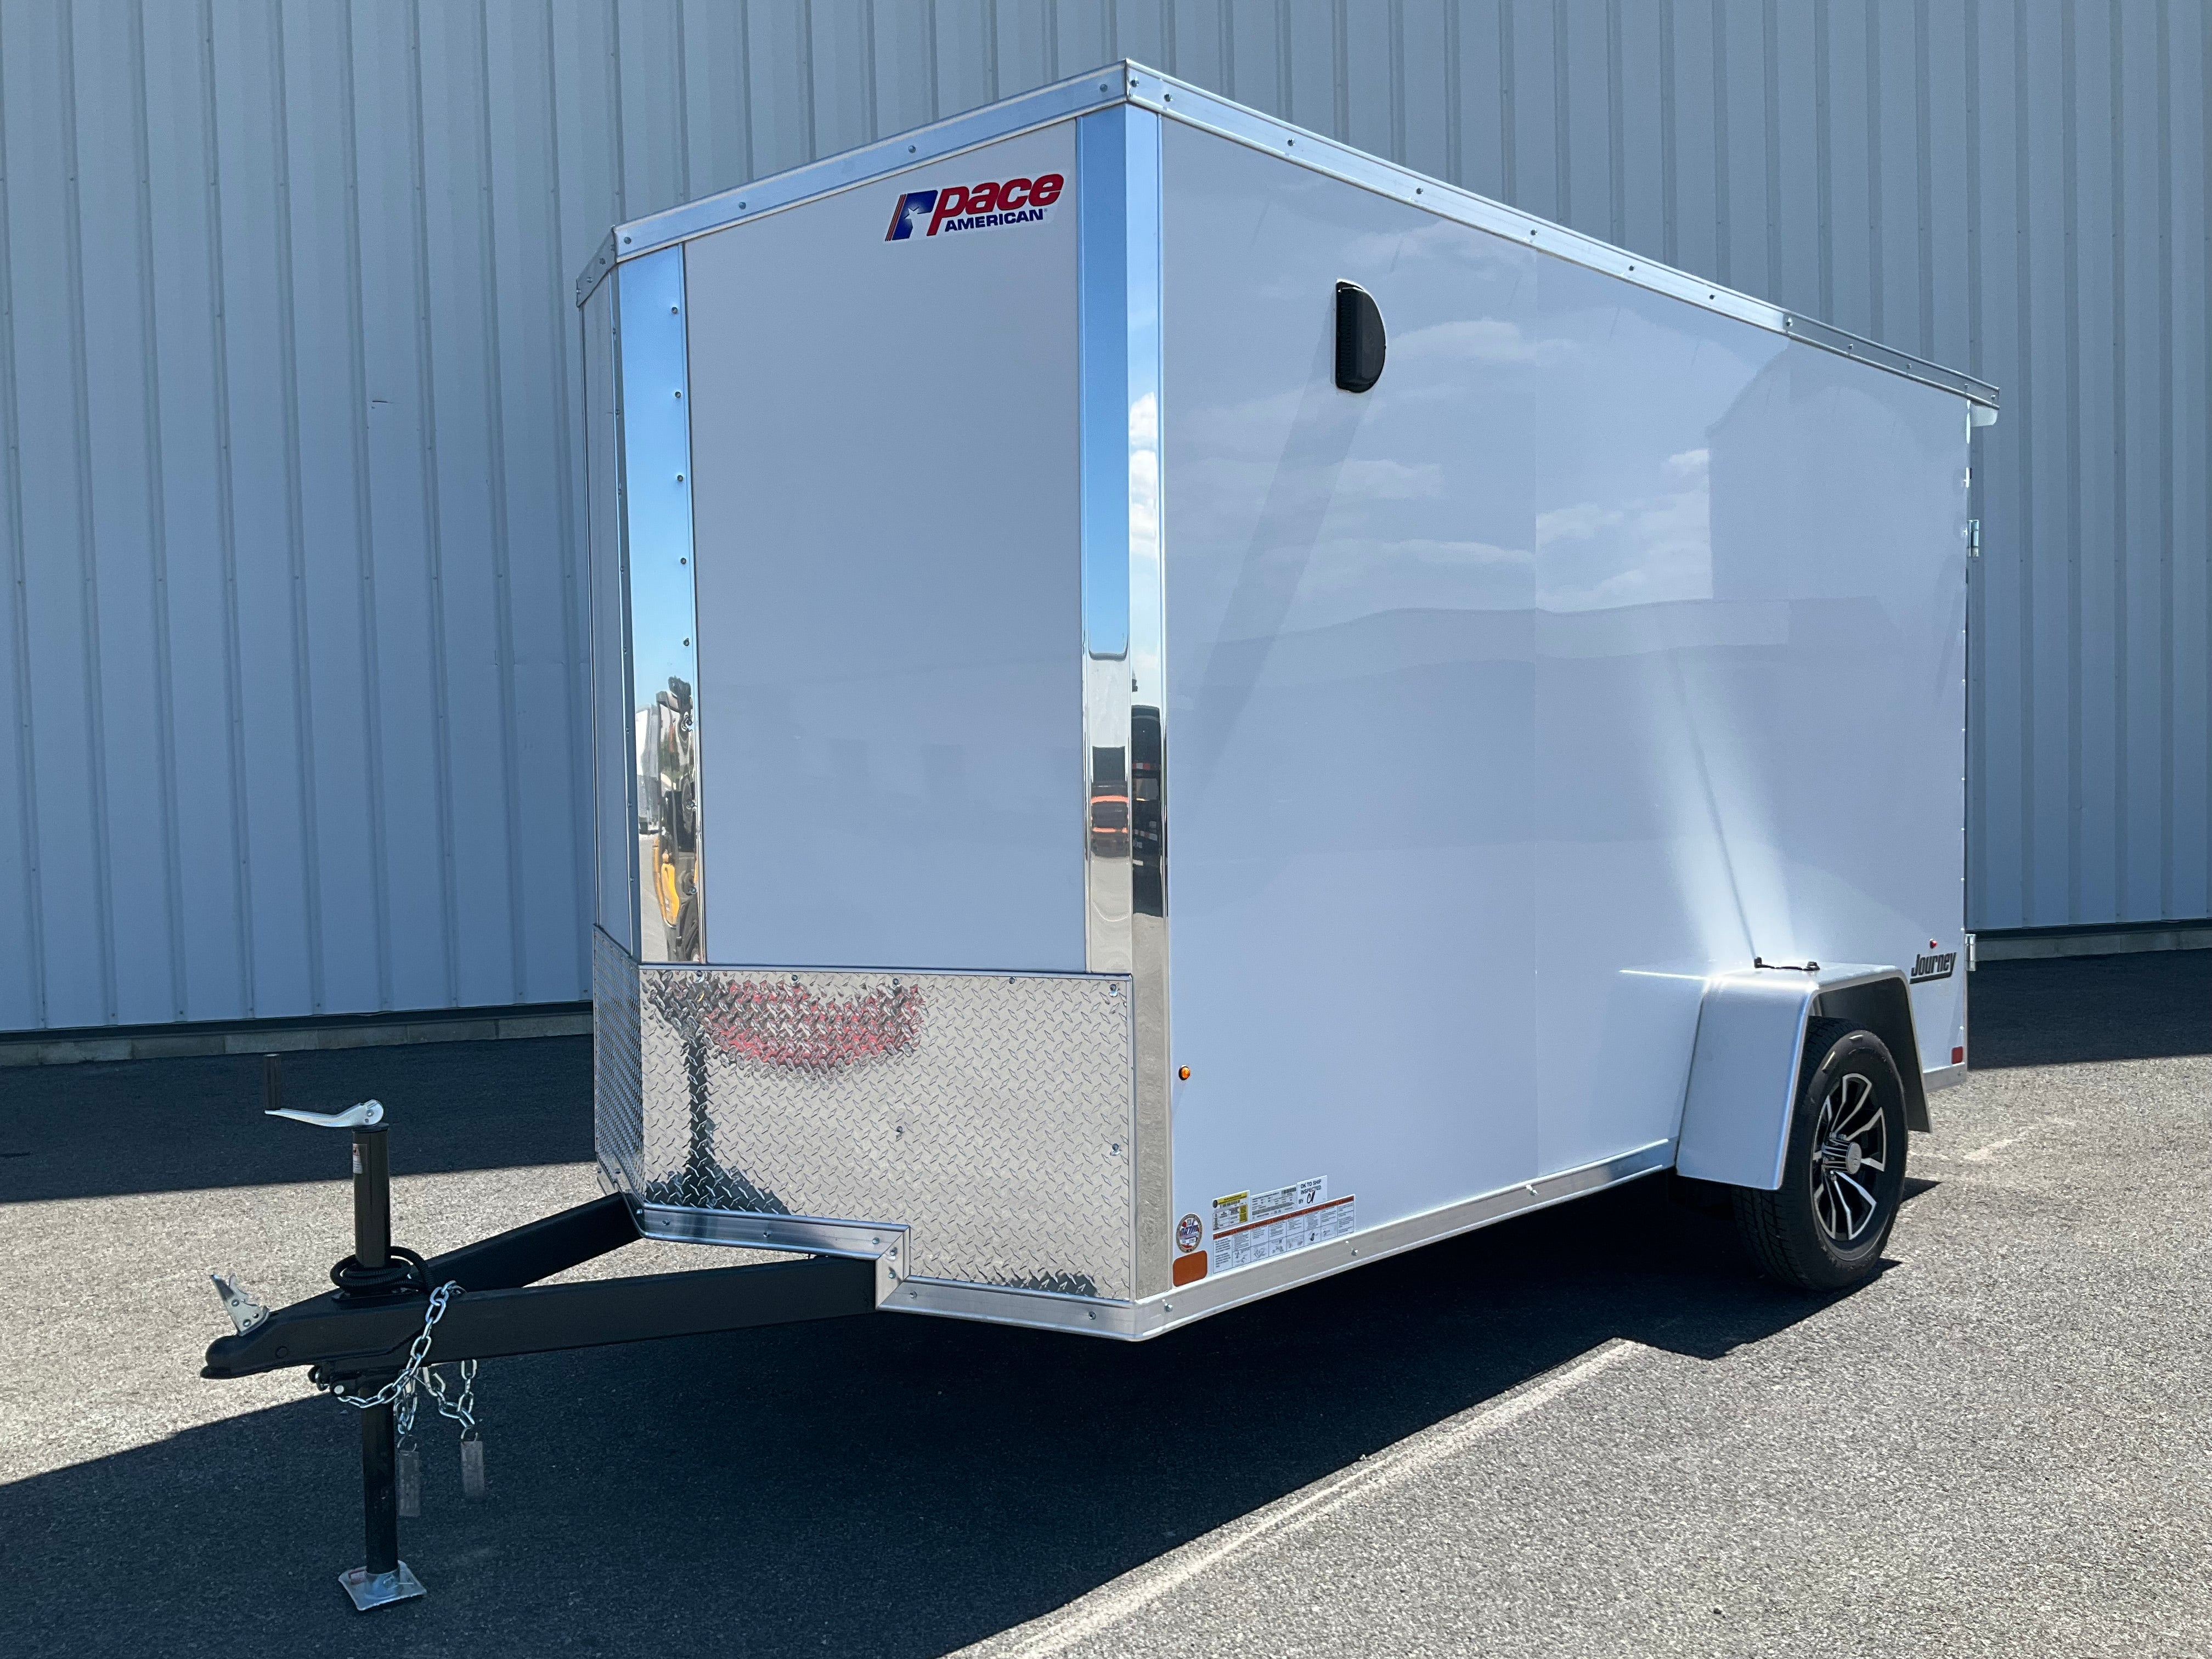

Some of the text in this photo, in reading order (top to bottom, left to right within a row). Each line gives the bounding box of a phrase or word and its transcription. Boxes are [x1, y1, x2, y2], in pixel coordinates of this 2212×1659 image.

[927, 173, 1064, 236] pace
[945, 208, 1044, 232] AMERICAN
[1910, 952, 1957, 977] Journey
[1300, 1185, 1322, 1195] INSPECTED
